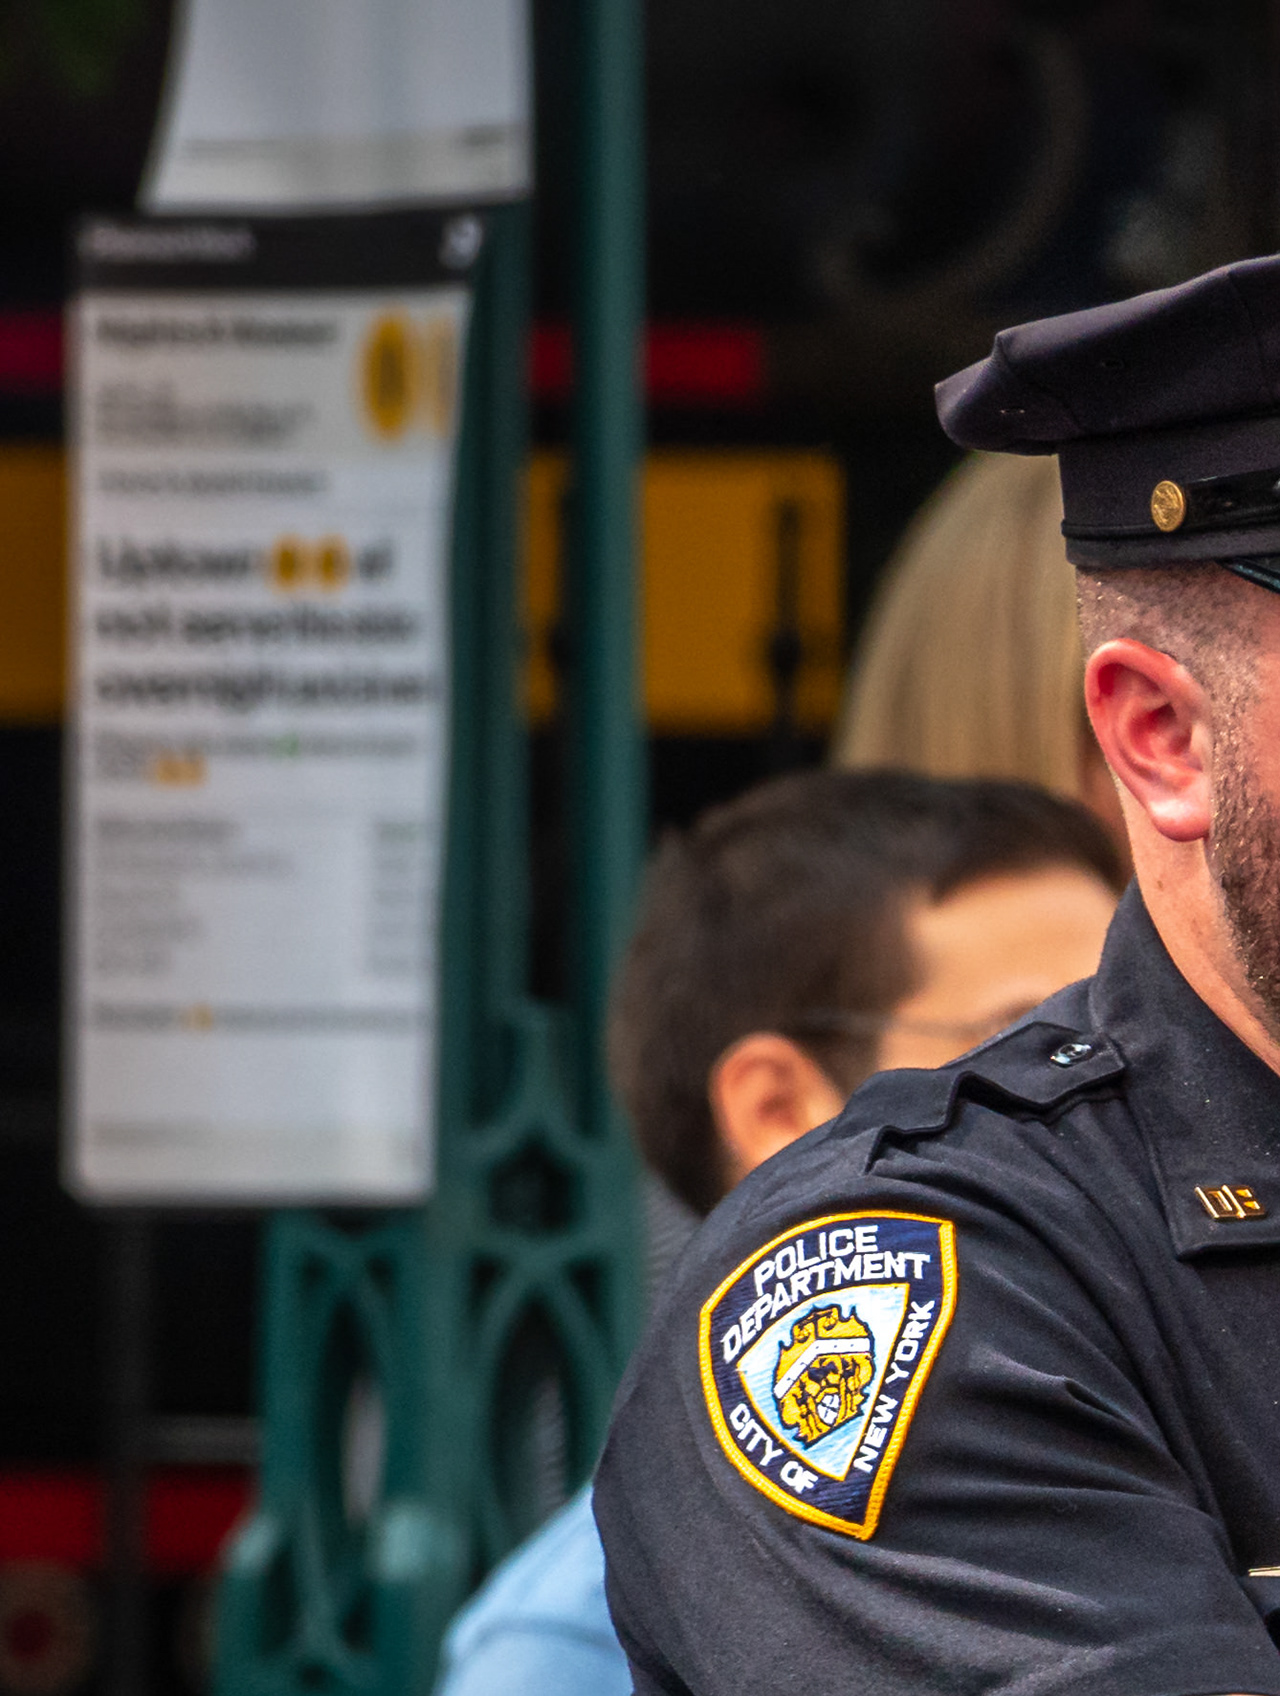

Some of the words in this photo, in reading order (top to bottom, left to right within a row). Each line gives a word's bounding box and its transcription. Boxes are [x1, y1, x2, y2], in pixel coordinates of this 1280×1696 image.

[721, 1251, 931, 1364] DEPARTMENT
[754, 1225, 878, 1296] POLICE
[853, 1394, 898, 1473] NEW
[885, 1300, 935, 1384] YORK
[730, 1403, 783, 1466] CITY
[780, 1461, 818, 1493] OF
